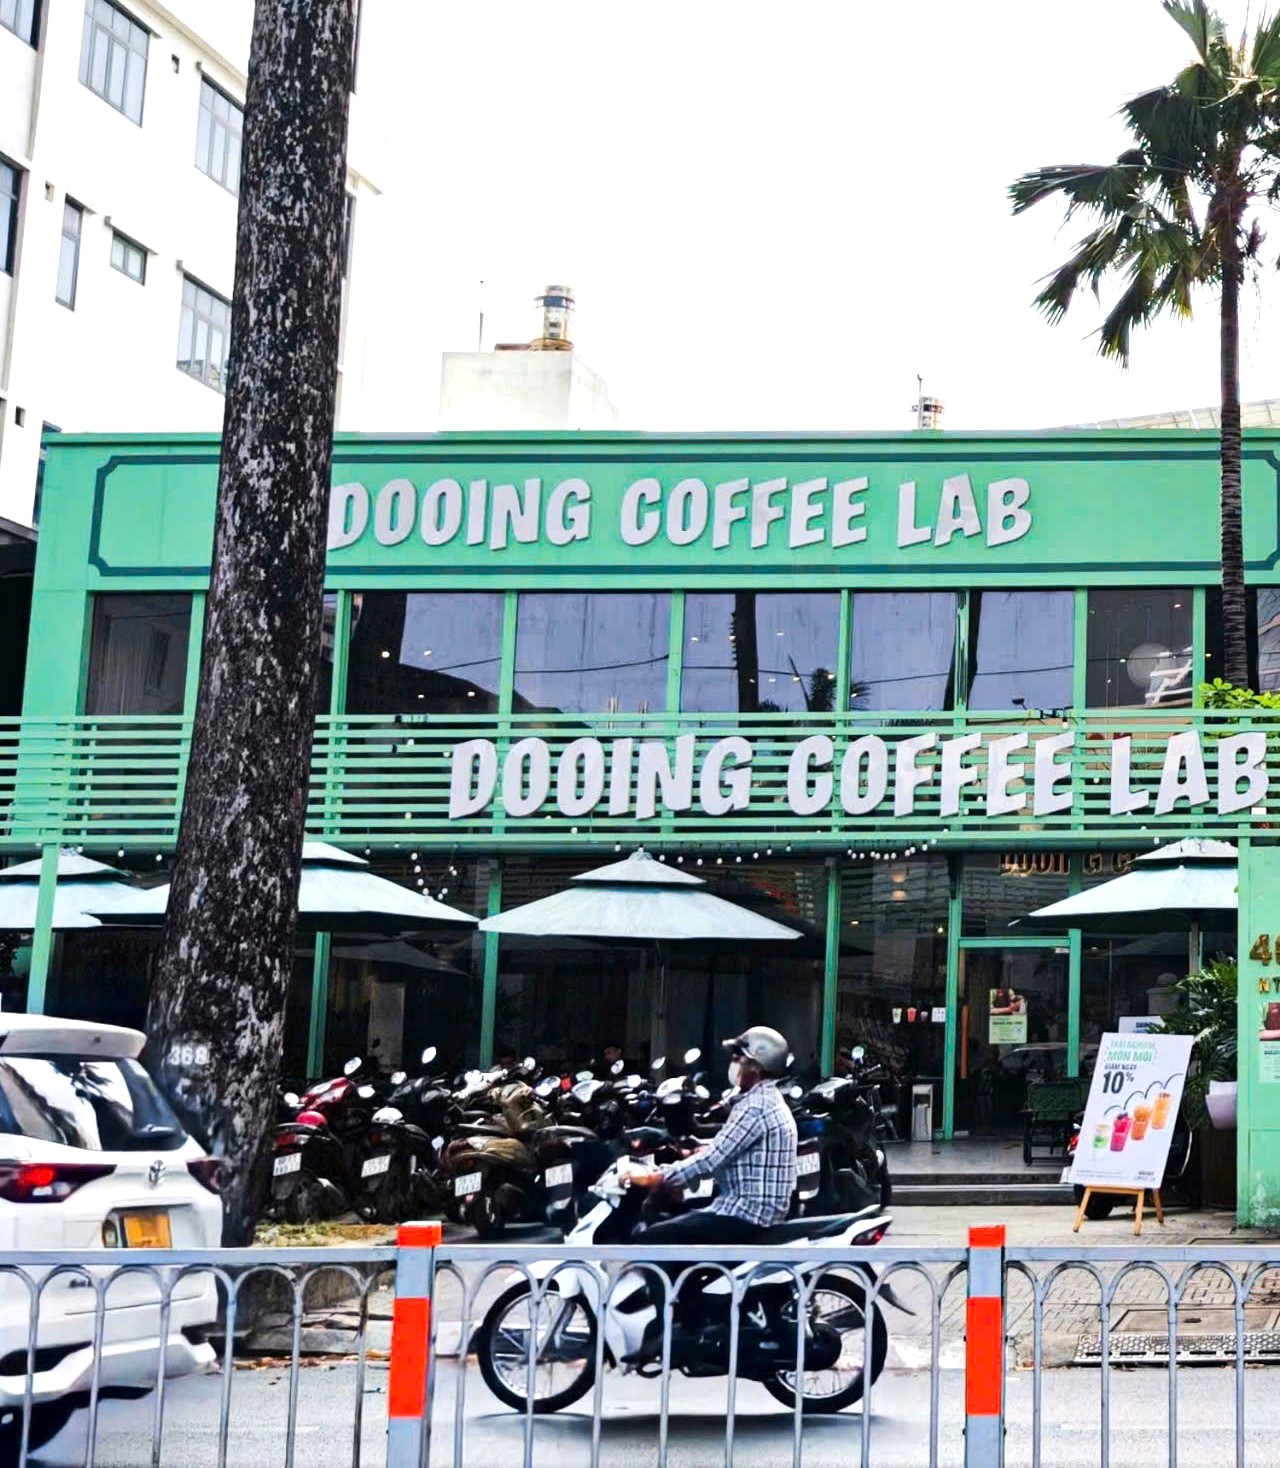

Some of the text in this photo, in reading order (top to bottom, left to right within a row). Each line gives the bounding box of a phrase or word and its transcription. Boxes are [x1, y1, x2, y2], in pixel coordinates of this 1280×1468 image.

[326, 473, 1031, 551] DOOING COFFEE LAB
[448, 729, 1270, 820] DOOING COFFEE LAB
[168, 1044, 210, 1066] 368
[1102, 1070, 1135, 1094] 10%
